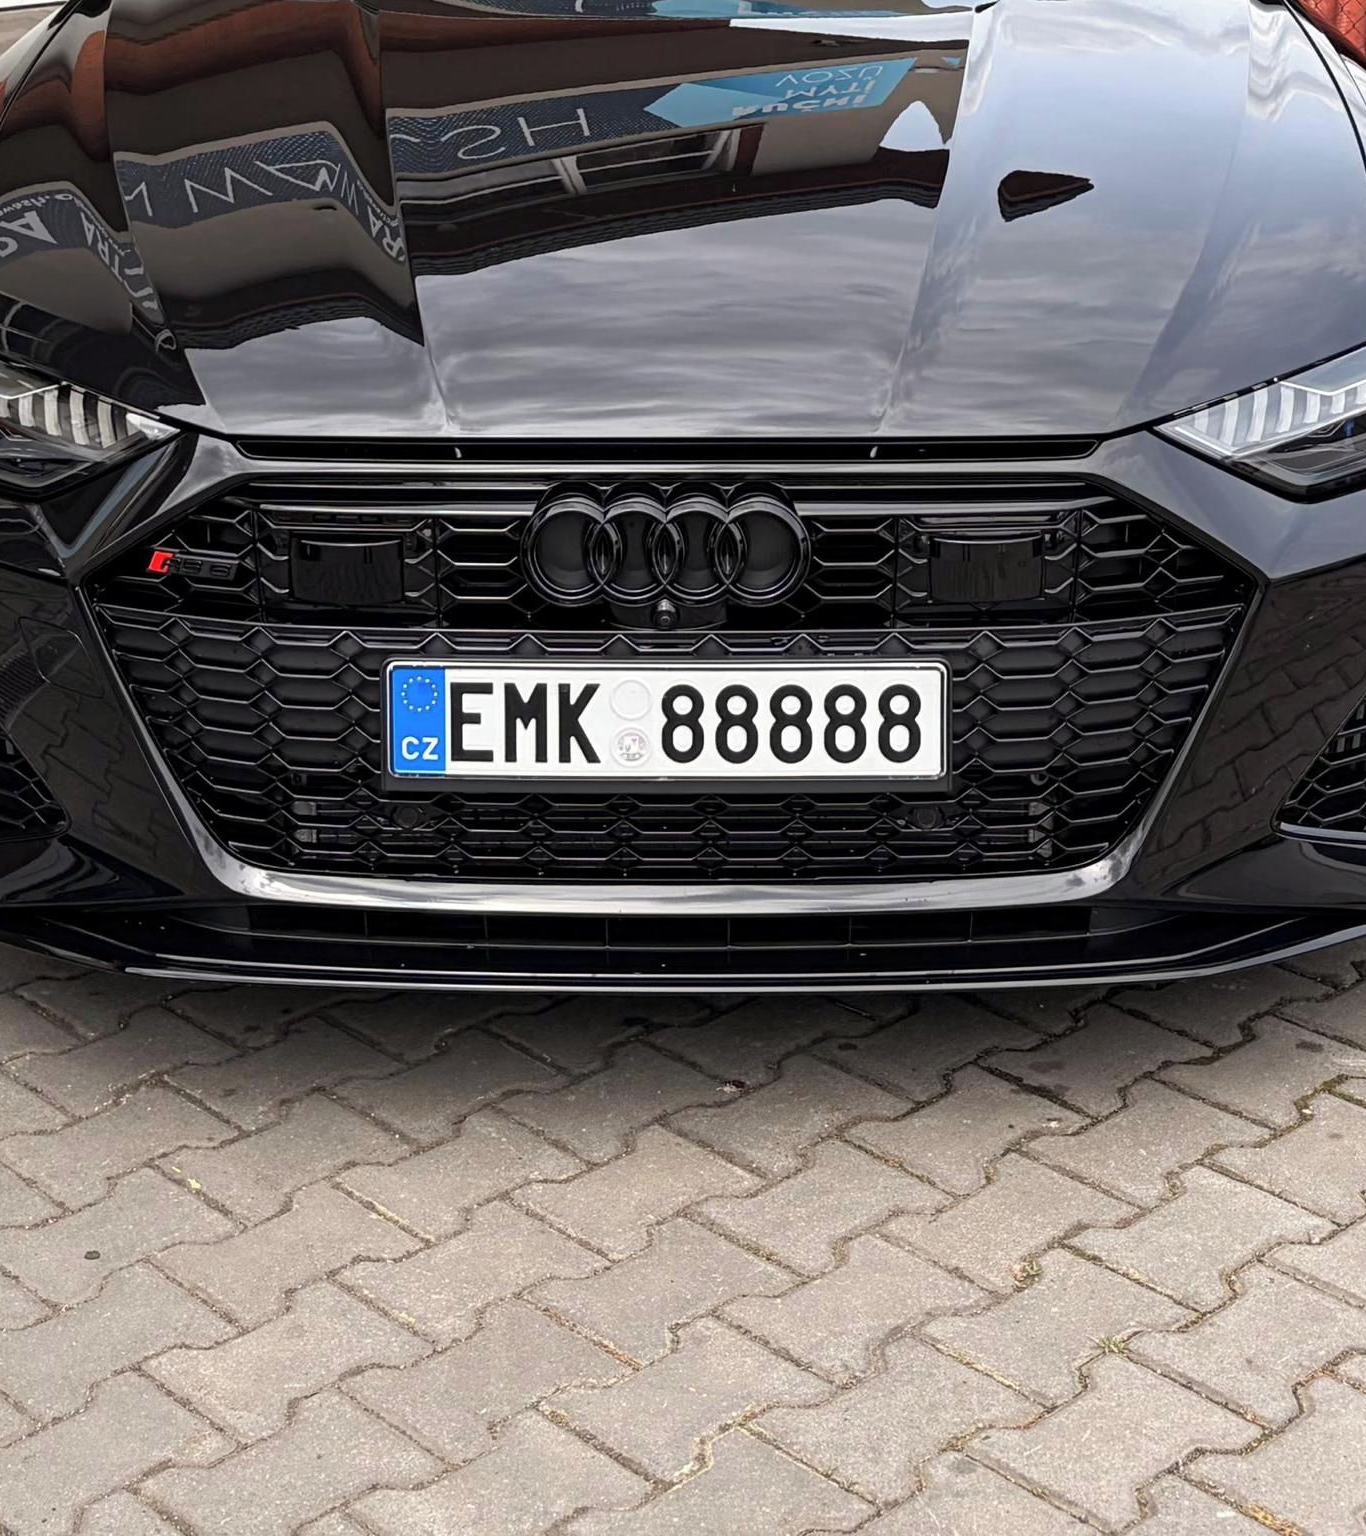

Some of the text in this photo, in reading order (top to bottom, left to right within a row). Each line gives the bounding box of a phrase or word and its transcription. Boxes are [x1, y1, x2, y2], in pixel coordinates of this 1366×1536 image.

[401, 736, 439, 761] CZ
[450, 682, 921, 764] EMK 88888
